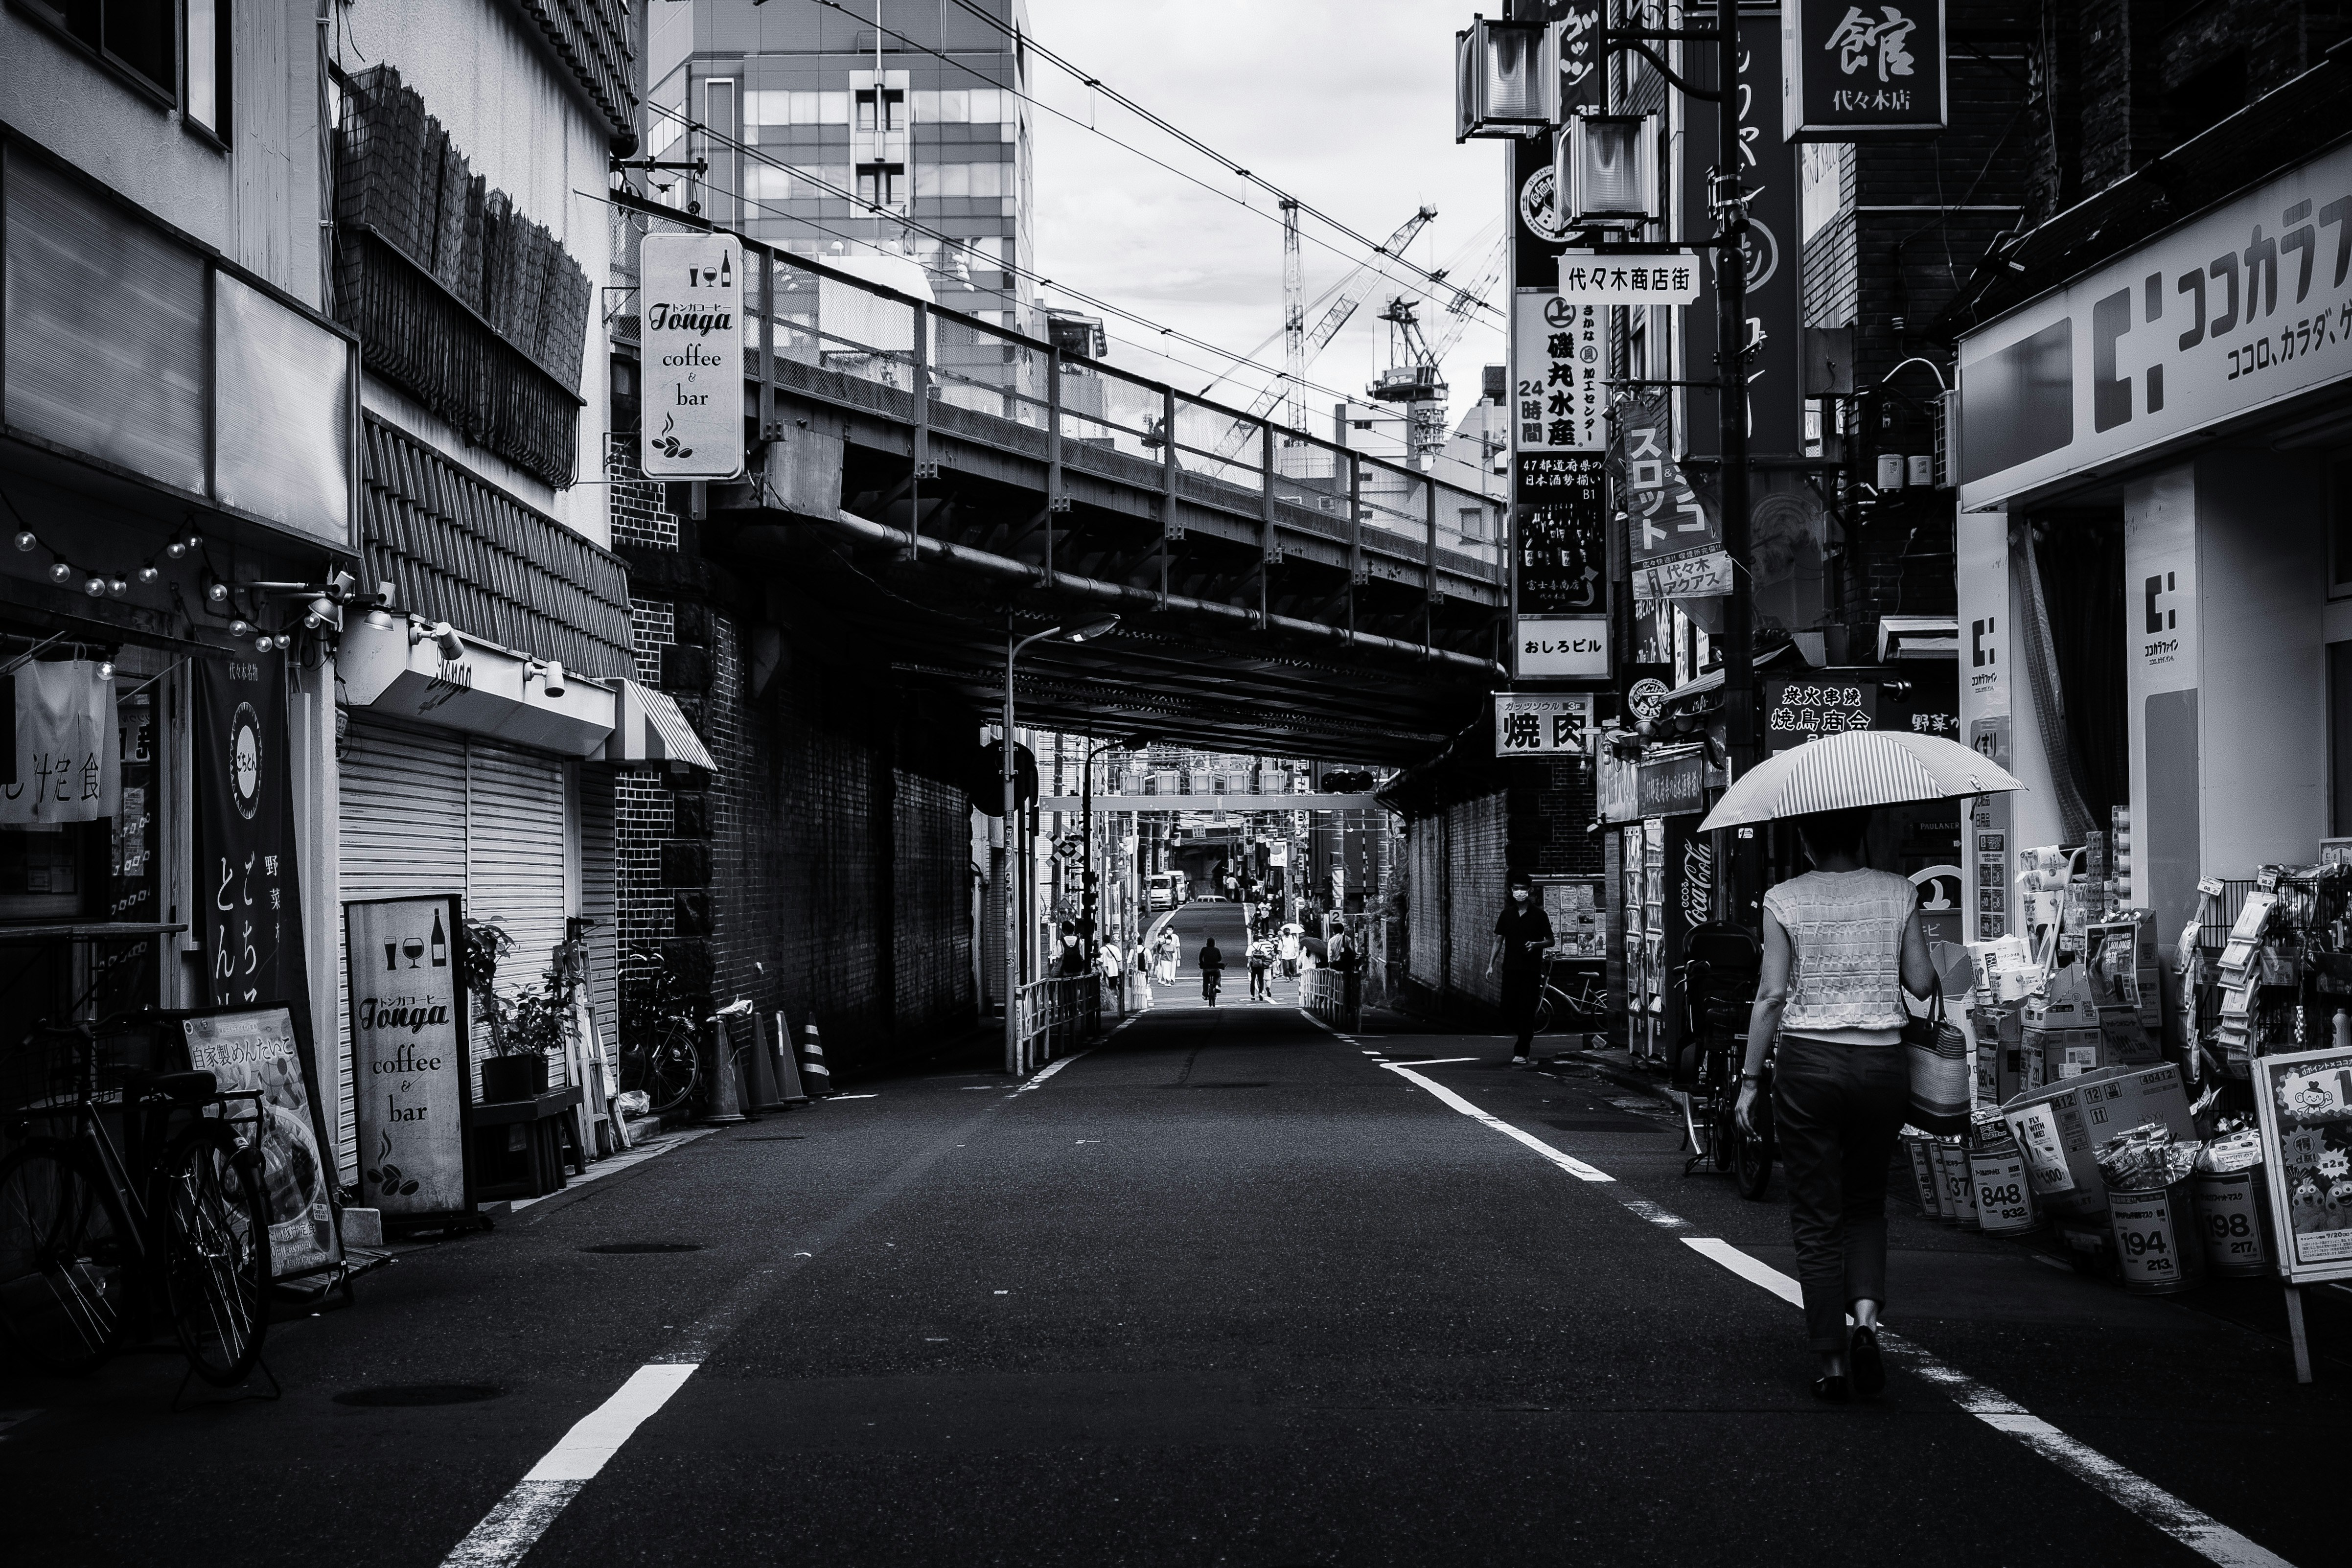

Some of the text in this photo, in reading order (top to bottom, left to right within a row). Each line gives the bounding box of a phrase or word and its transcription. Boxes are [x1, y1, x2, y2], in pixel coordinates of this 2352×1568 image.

[1825, 6, 1916, 82] 館
[1833, 89, 1911, 111] 代々木店
[1569, 267, 1690, 291] 代々木商店街
[672, 303, 731, 312] トンガコーヒー
[648, 302, 733, 337] Tonga
[663, 343, 721, 366] coffee
[688, 372, 697, 382] &
[676, 383, 709, 406] bar
[1547, 331, 1576, 446] 磯丸水産
[1519, 380, 1545, 443] 24時間
[1523, 459, 1602, 472] 47都道府県の
[1664, 468, 1672, 478] &
[1526, 474, 1601, 486] 日本酒勢揃い
[1631, 427, 1667, 550] スロット
[1583, 490, 1595, 500] B1
[1666, 558, 1710, 580] 代々木
[1663, 572, 1720, 596] アクアス
[1525, 638, 1602, 654] おしろビル
[2144, 639, 2179, 657] ココカラファイン
[230, 662, 258, 682] 代々木名物
[1972, 672, 1997, 686] ココカラファイン
[1505, 701, 1581, 711] ガッツソウル 3F
[1782, 685, 1862, 707] 炭火串焼
[1503, 712, 1586, 749] 焼肉
[1771, 708, 1871, 732] 焼鳥商会
[237, 751, 257, 772] ごちとん
[1332, 911, 1340, 922] 2
[380, 994, 446, 1007] トンガコーヒー
[359, 997, 450, 1034] Tonga
[192, 1038, 294, 1069] 自家製めんたいこ
[372, 1043, 441, 1076] coffee
[400, 1079, 411, 1093] &
[2143, 1070, 2172, 1084] 40412
[2087, 1088, 2099, 1101] 12
[388, 1095, 427, 1123] bar
[2029, 1115, 2040, 1125] FLY
[2029, 1122, 2045, 1132] WITH
[1981, 1183, 2022, 1207] 848
[2002, 1206, 2025, 1219] 932
[2205, 1213, 2251, 1239] 198
[2121, 1230, 2167, 1256] 194
[2230, 1241, 2253, 1254] 217
[2146, 1258, 2170, 1271] 213
